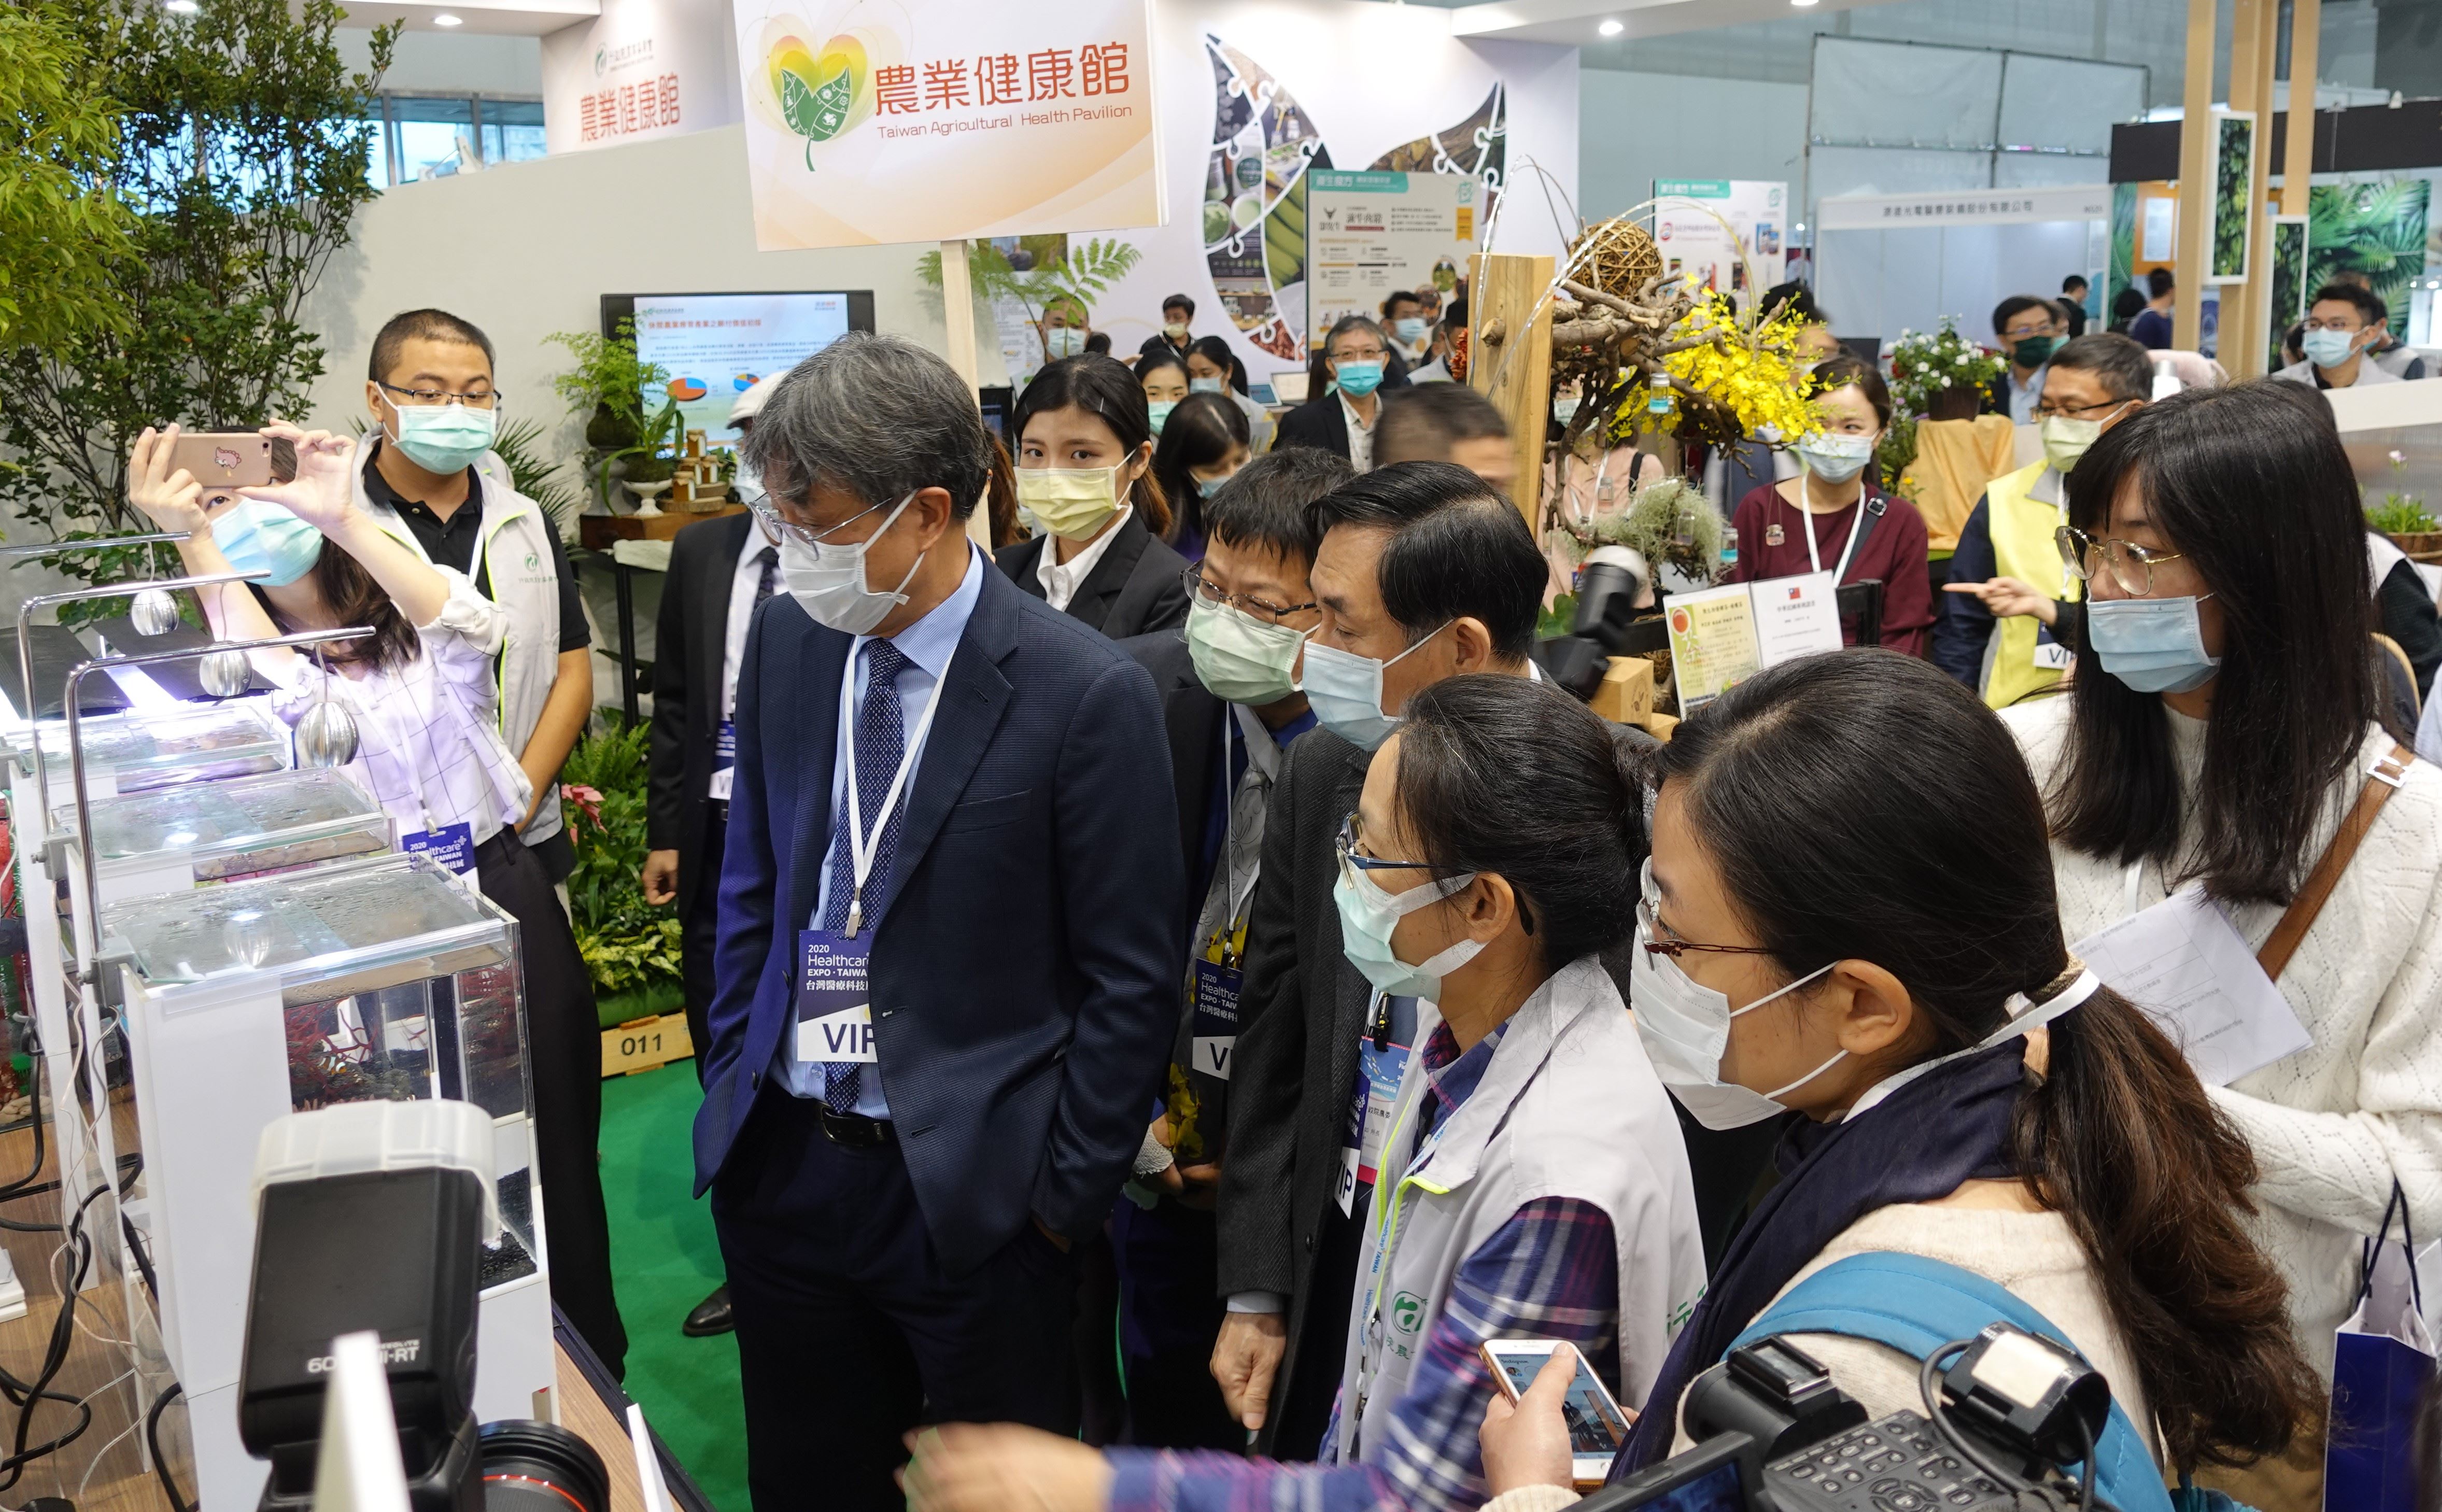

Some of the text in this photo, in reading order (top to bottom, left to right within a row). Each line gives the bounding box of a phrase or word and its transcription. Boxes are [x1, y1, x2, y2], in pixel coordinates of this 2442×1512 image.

[876, 41, 1129, 116] 農業健康館
[581, 72, 680, 143] 農業健康館
[878, 105, 1132, 138] Taiwan Agricultural Health Pavilion
[410, 842, 427, 851] 2020
[808, 944, 829, 953] 2020
[806, 980, 869, 991] 台灣醫療科技
[1202, 972, 1217, 983] 2020
[1201, 993, 1217, 1004] EXPO
[622, 1034, 661, 1056] 011
[1372, 1251, 1382, 1274] TAIWAN
